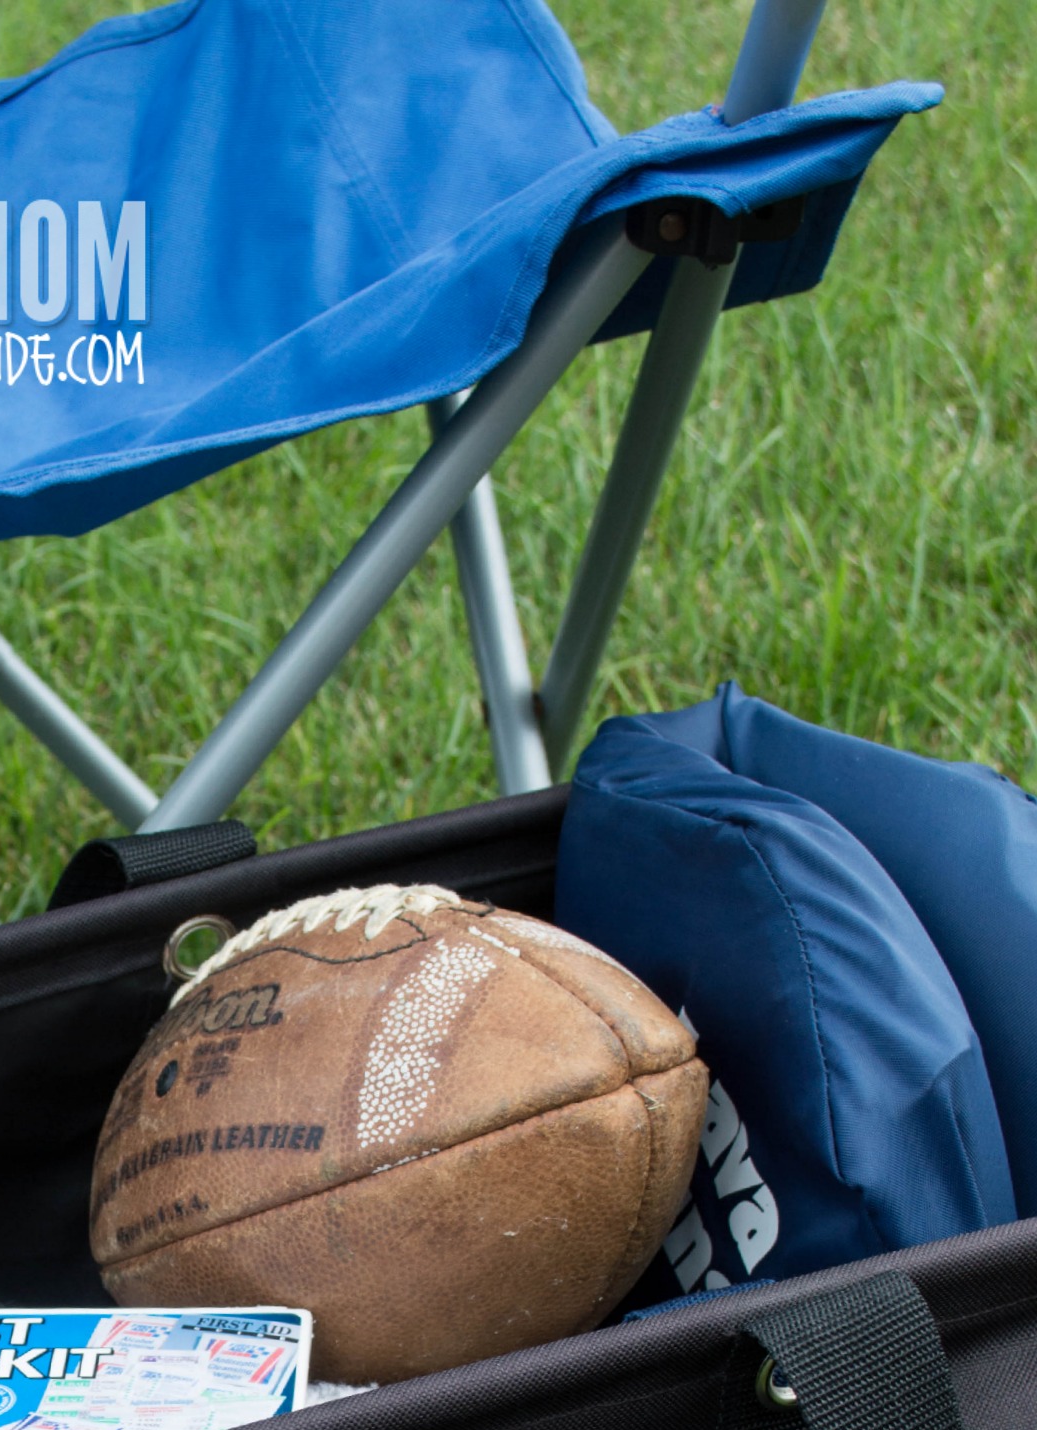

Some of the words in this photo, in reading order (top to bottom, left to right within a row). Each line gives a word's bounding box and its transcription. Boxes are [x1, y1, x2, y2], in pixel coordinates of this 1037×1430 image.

[213, 1121, 326, 1152] LEATHER
[196, 1317, 254, 1331] FIRST
[256, 1320, 292, 1336] AID
